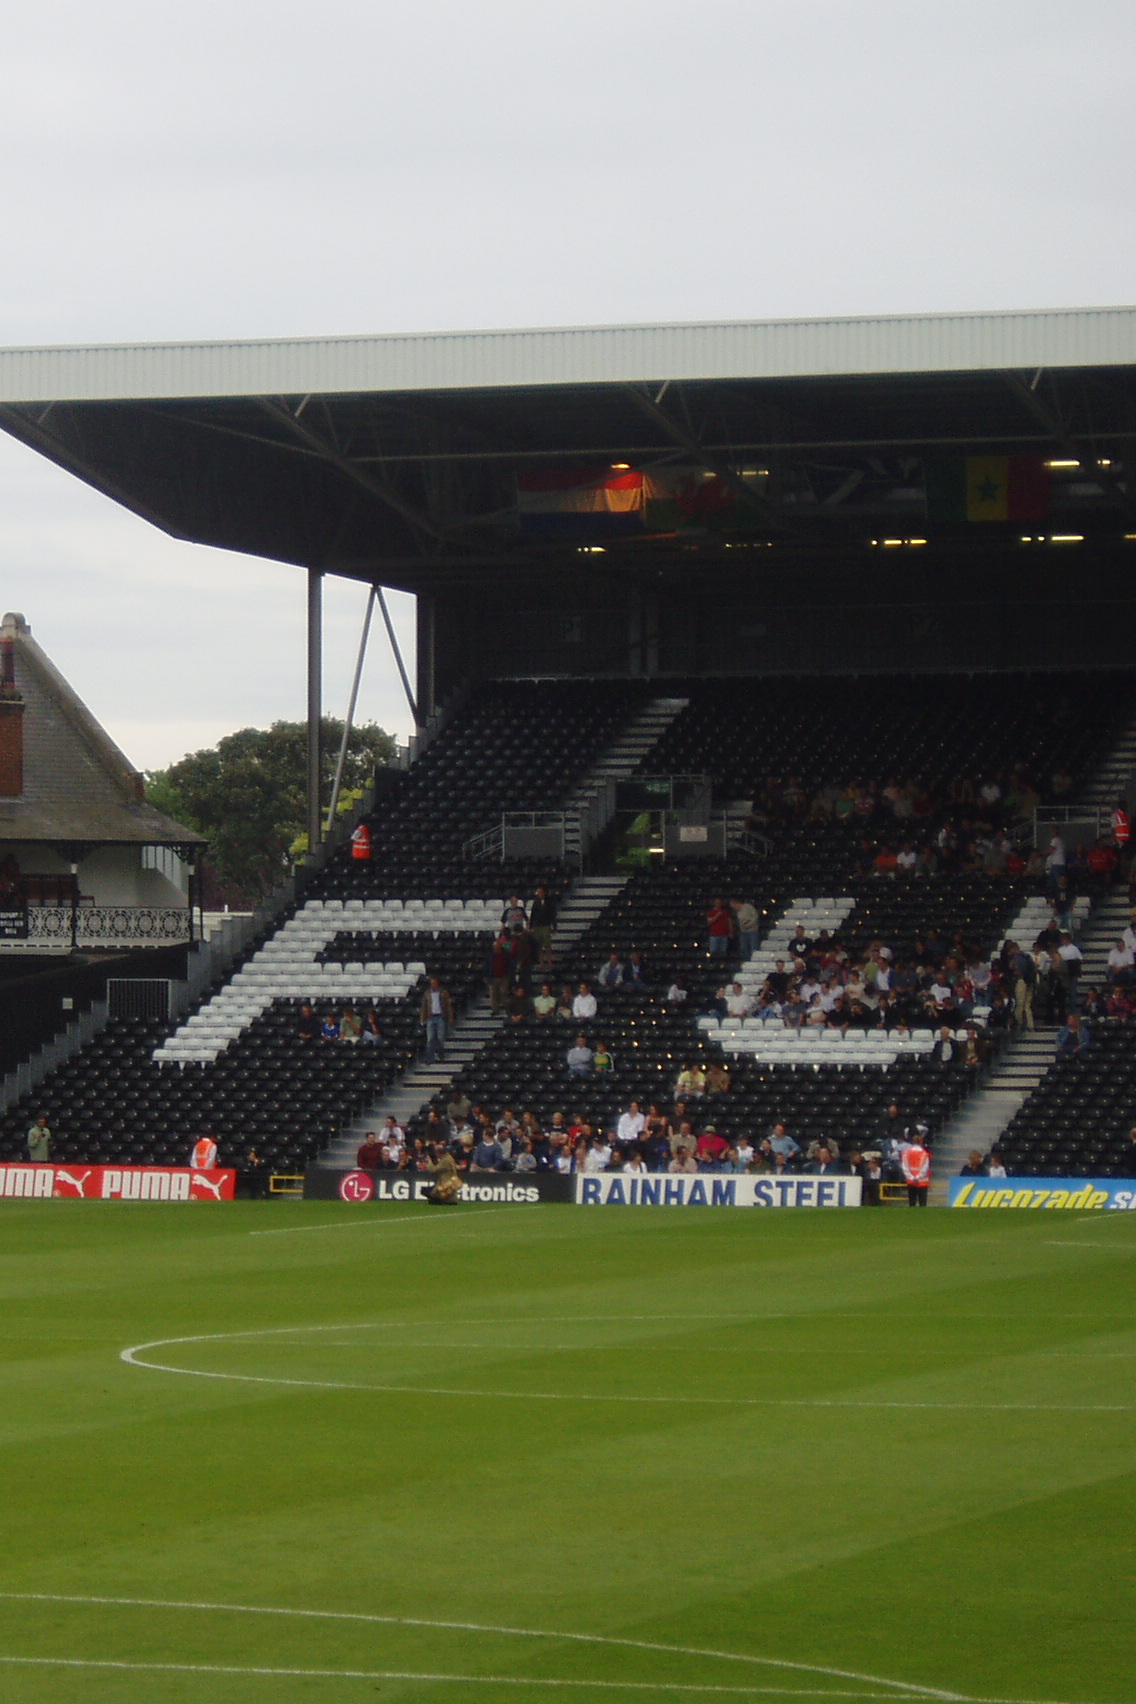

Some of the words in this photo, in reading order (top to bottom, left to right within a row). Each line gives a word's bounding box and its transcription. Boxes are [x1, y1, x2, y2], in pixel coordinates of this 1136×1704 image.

[102, 1169, 190, 1200] PUMA
[379, 1180, 410, 1200] LG
[415, 1181, 539, 1202] Etronics
[582, 1177, 736, 1206] RAINHAM
[952, 1182, 1110, 1209] Lucozade
